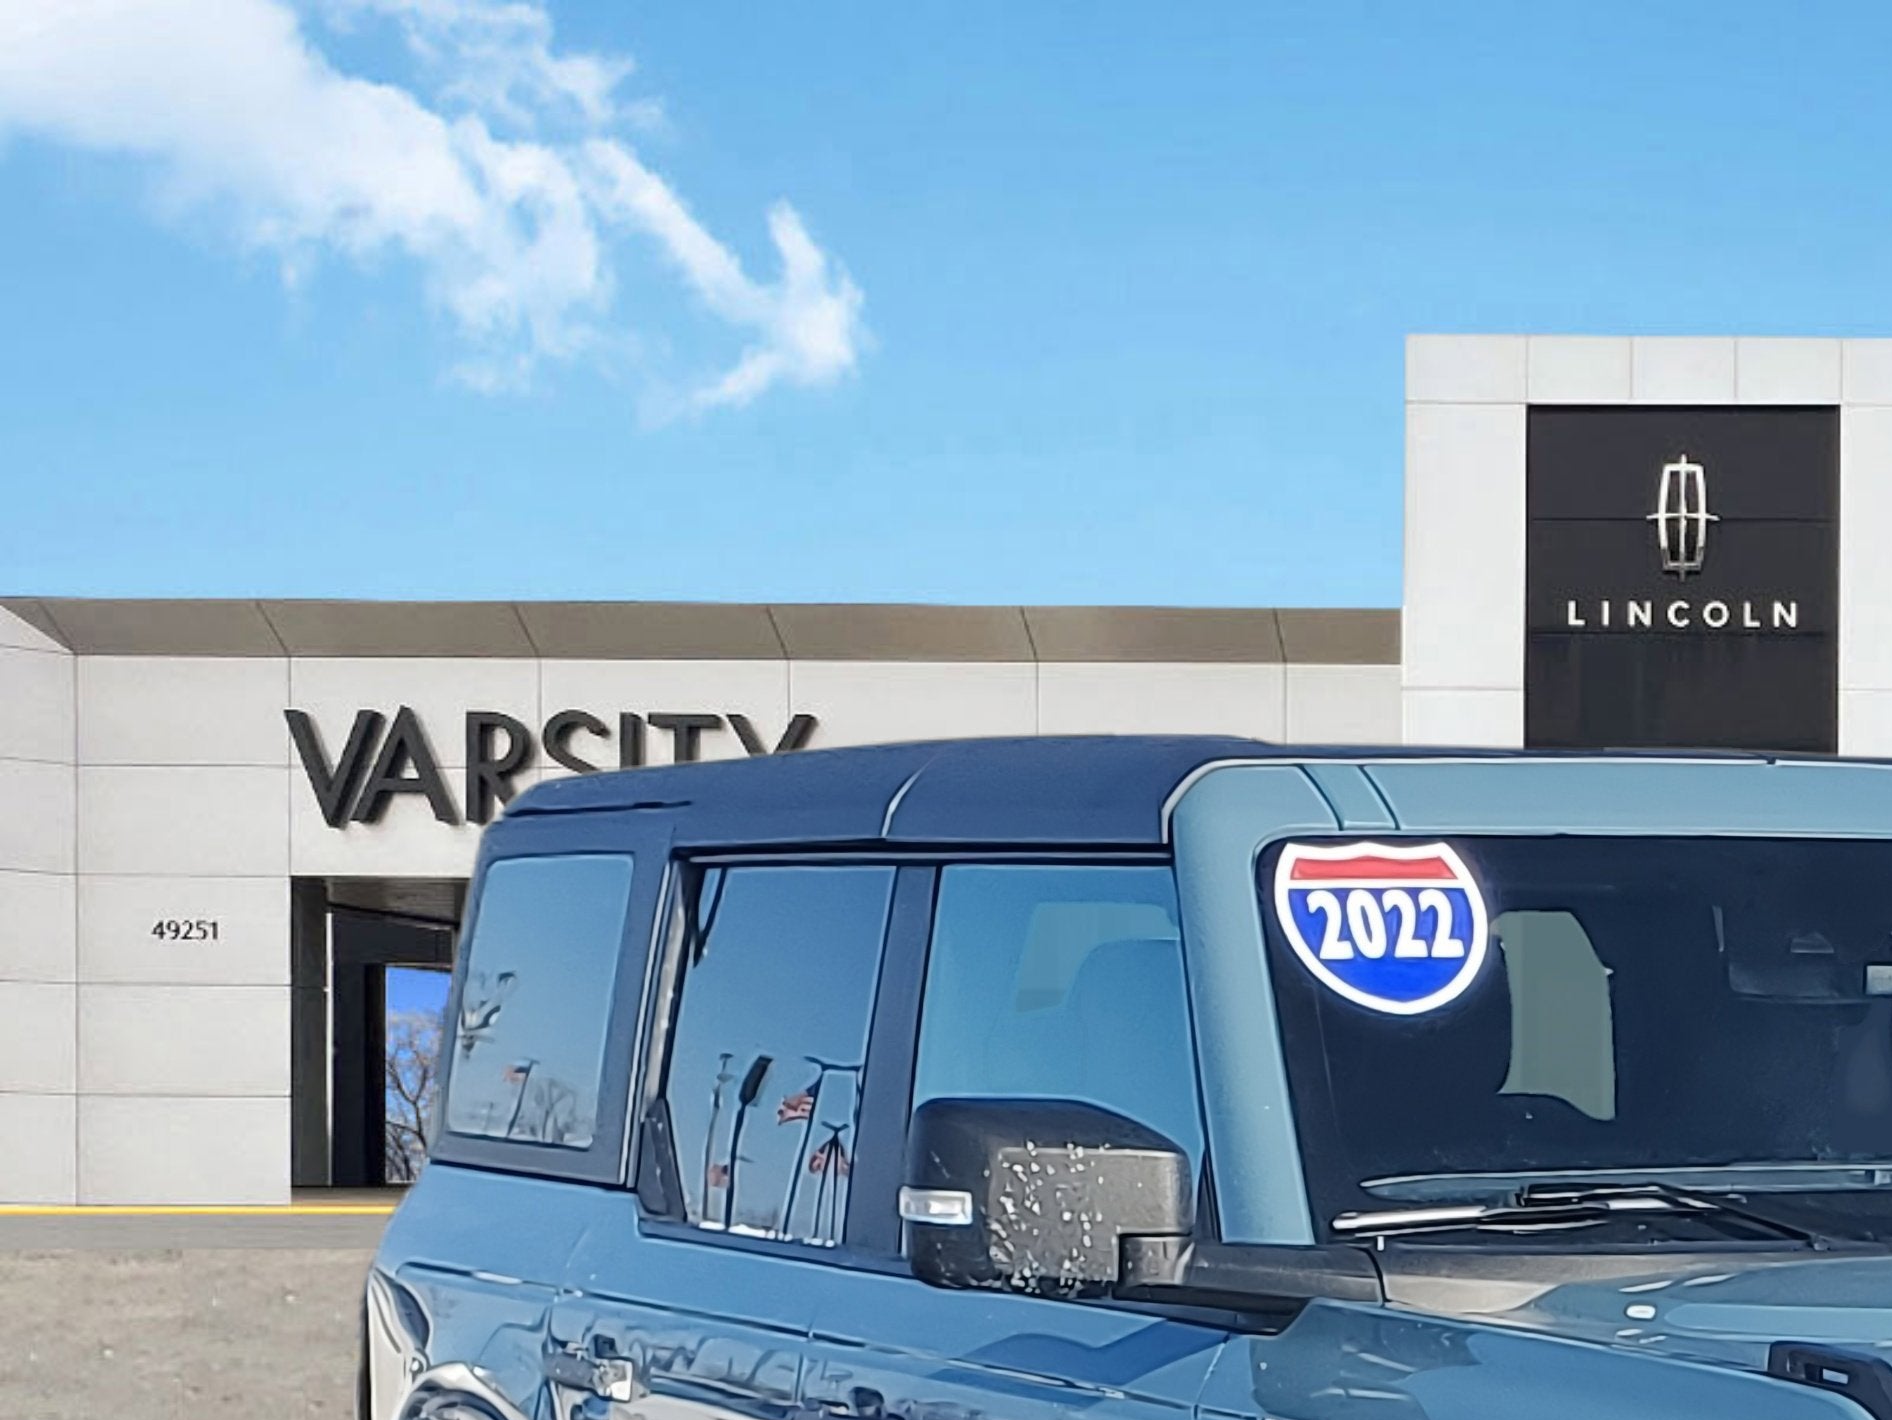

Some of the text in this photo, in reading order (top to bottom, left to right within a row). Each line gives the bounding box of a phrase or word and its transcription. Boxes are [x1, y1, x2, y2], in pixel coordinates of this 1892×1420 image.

[1567, 600, 1799, 629] LINCOLN
[151, 919, 219, 942] 49251
[1306, 888, 1465, 960] 2022
